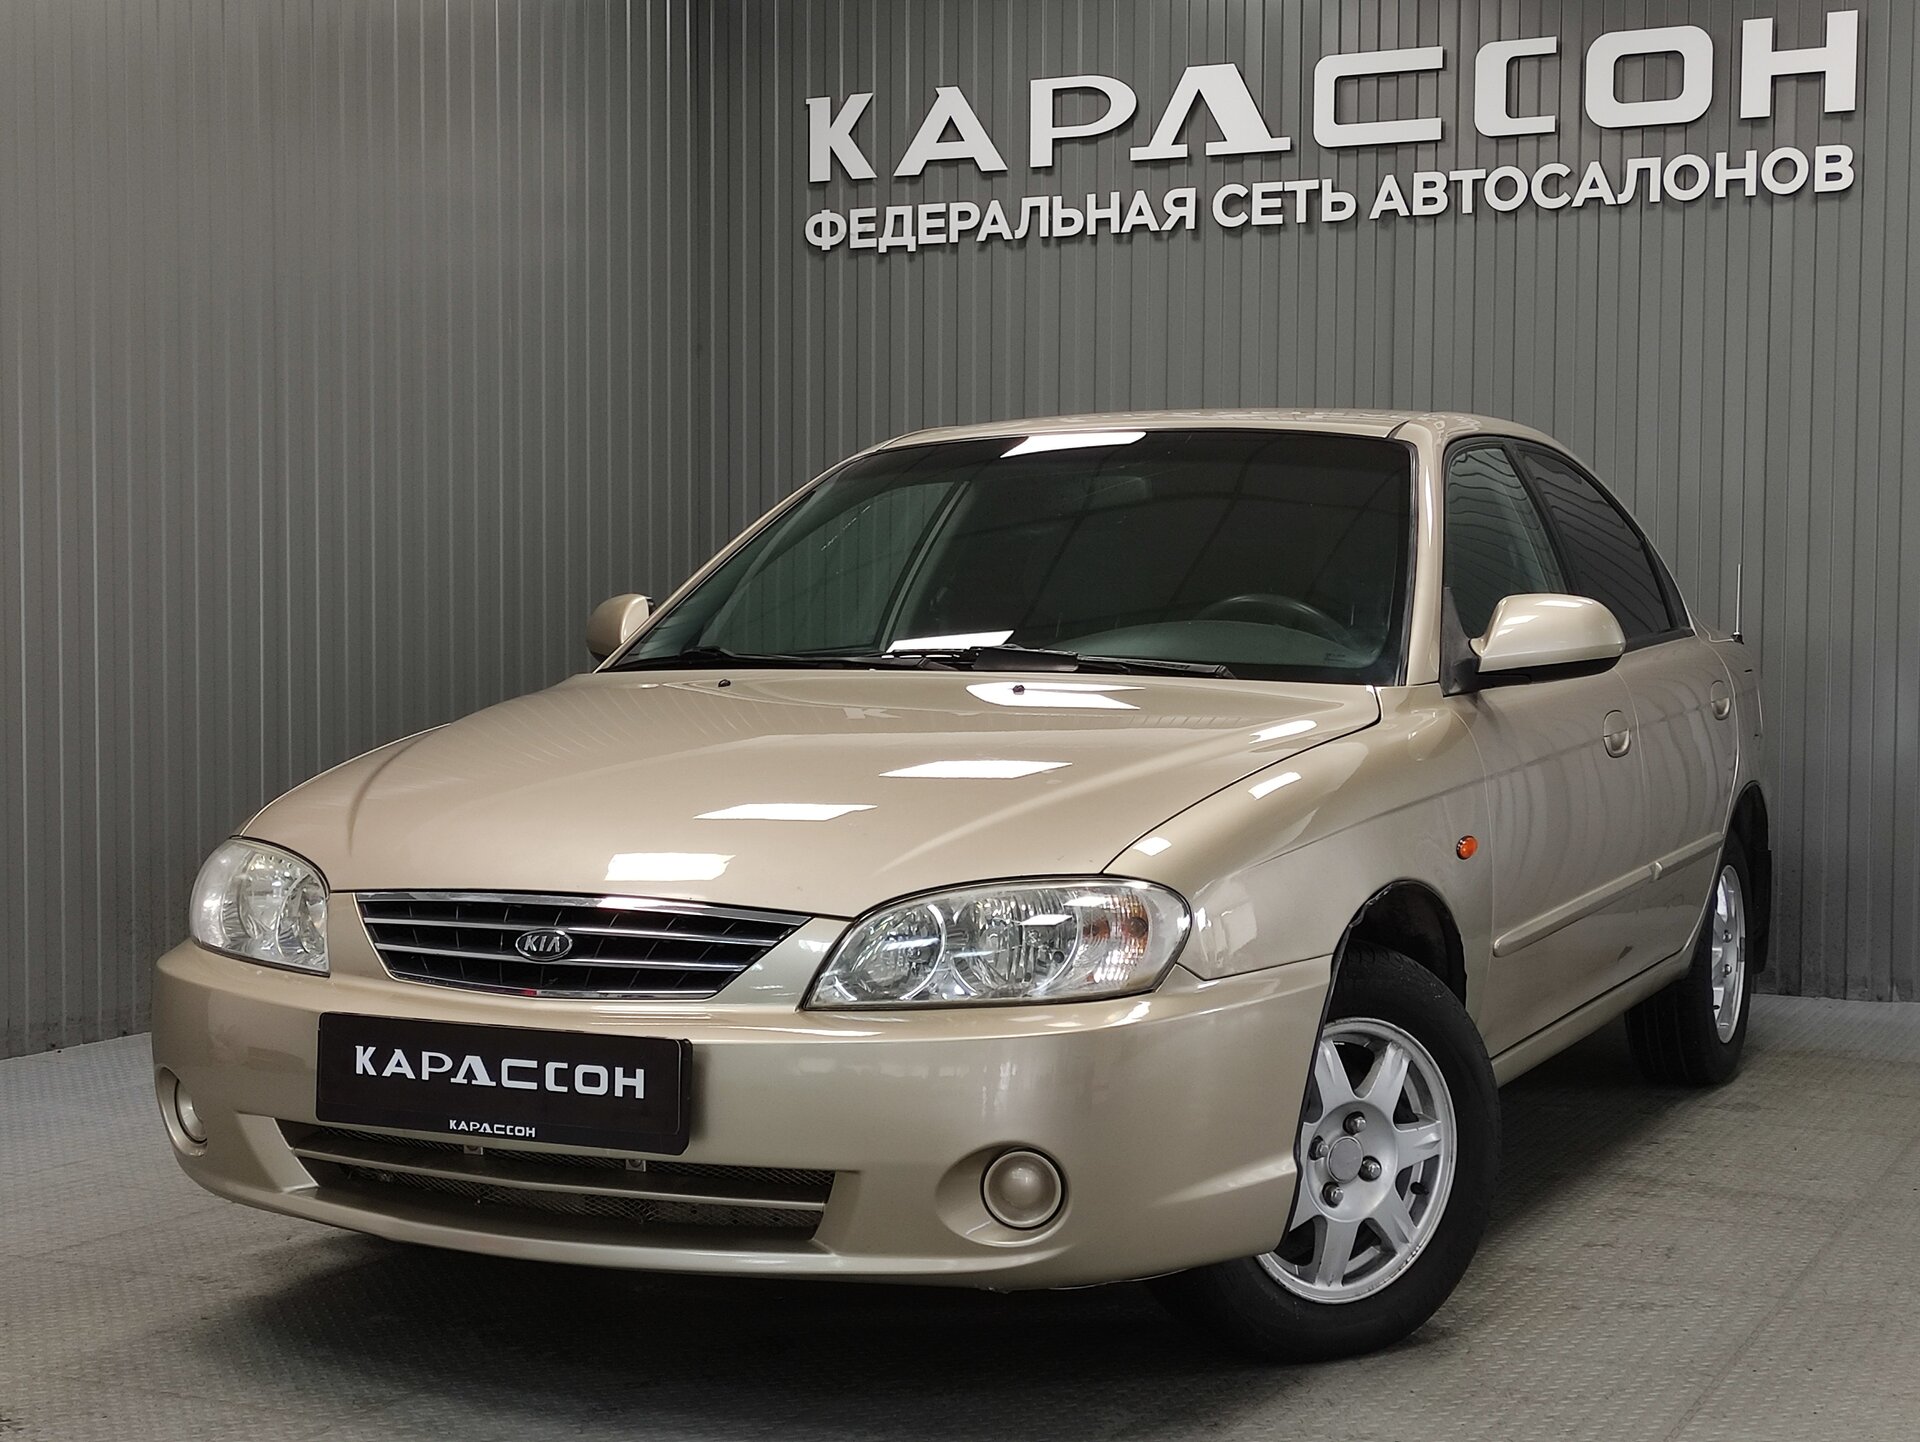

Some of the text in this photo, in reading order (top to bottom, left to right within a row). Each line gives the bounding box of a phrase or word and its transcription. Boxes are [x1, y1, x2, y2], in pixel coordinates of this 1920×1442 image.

[804, 144, 1855, 253] ФЕДЕРАЛЬНАЯ СЕТЬ АВТОСАЛОНОВ
